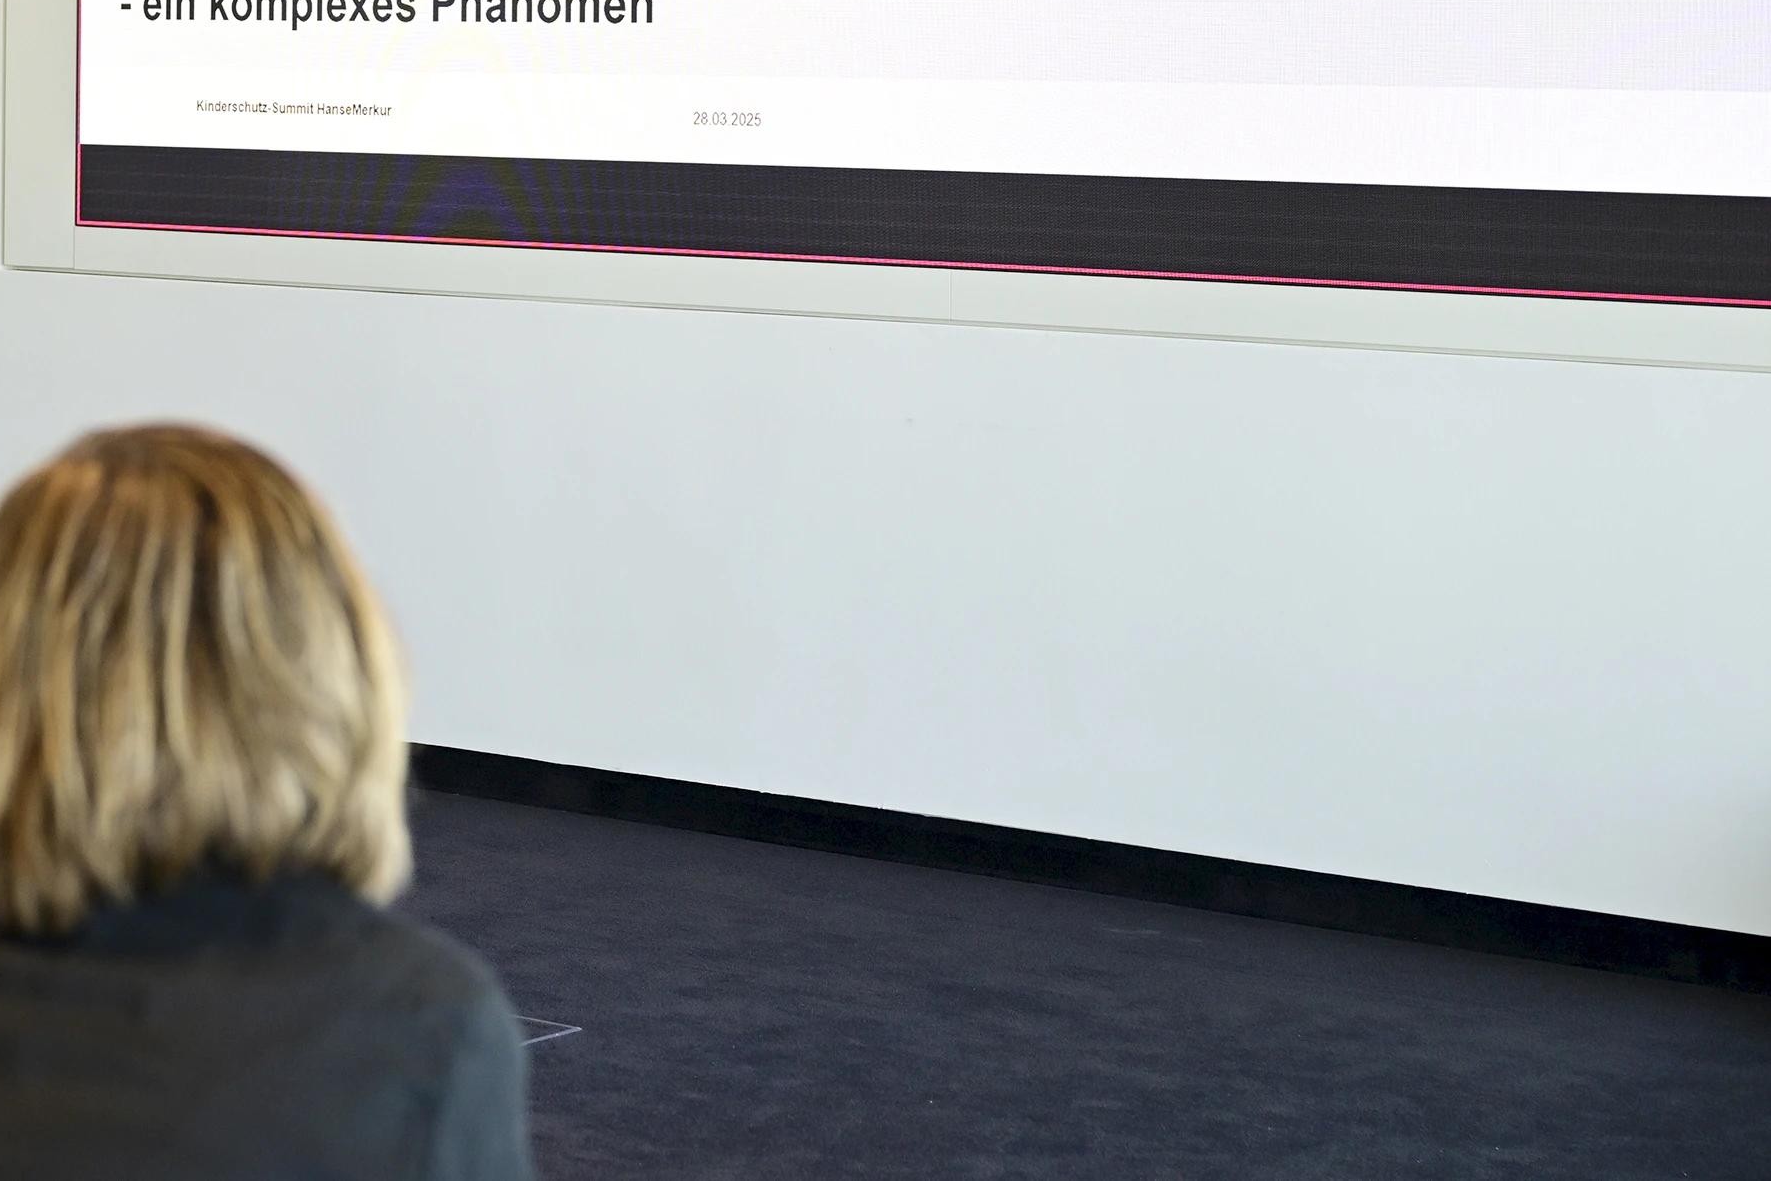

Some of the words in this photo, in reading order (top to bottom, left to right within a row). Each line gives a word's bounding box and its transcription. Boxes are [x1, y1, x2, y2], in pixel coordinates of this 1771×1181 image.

[196, 100, 314, 115] Kinderschutz-Summit
[317, 103, 392, 116] HanseMerkur
[693, 111, 762, 127] 28.03.2025
